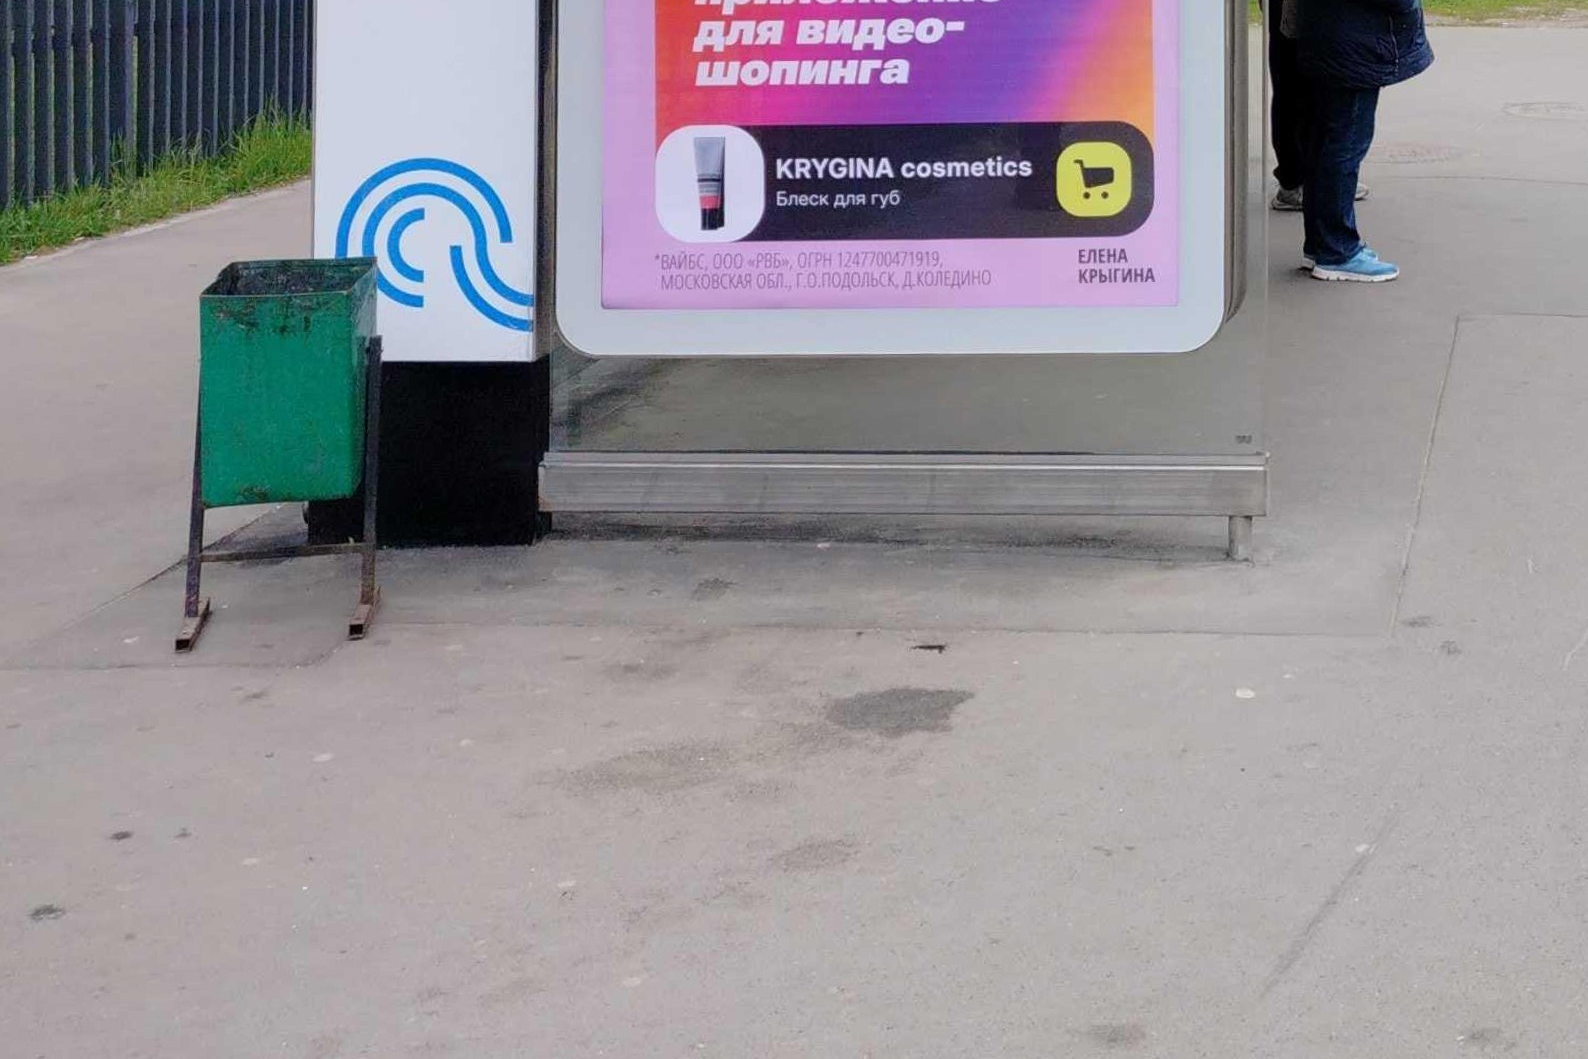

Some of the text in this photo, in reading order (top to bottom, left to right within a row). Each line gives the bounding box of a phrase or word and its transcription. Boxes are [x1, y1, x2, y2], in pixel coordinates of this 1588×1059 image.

[692, 17, 966, 53] для видео-
[695, 58, 910, 86] шопинга
[776, 157, 1033, 180] KRYGINA cosmetics
[776, 190, 901, 210] Блеск для губ
[713, 253, 744, 270] ООО
[749, 253, 793, 272] «РВБ»,
[797, 252, 833, 269] ОГРН
[837, 251, 943, 269] 1247700471919,
[1078, 248, 1129, 264] ЕЛЕНА
[661, 273, 751, 290] МОСКОВСКАЯ
[756, 273, 793, 291] ОБЛ.,
[902, 270, 992, 290] Д.КОЛЕДИНО
[1078, 268, 1156, 284] КРЫГИНА
